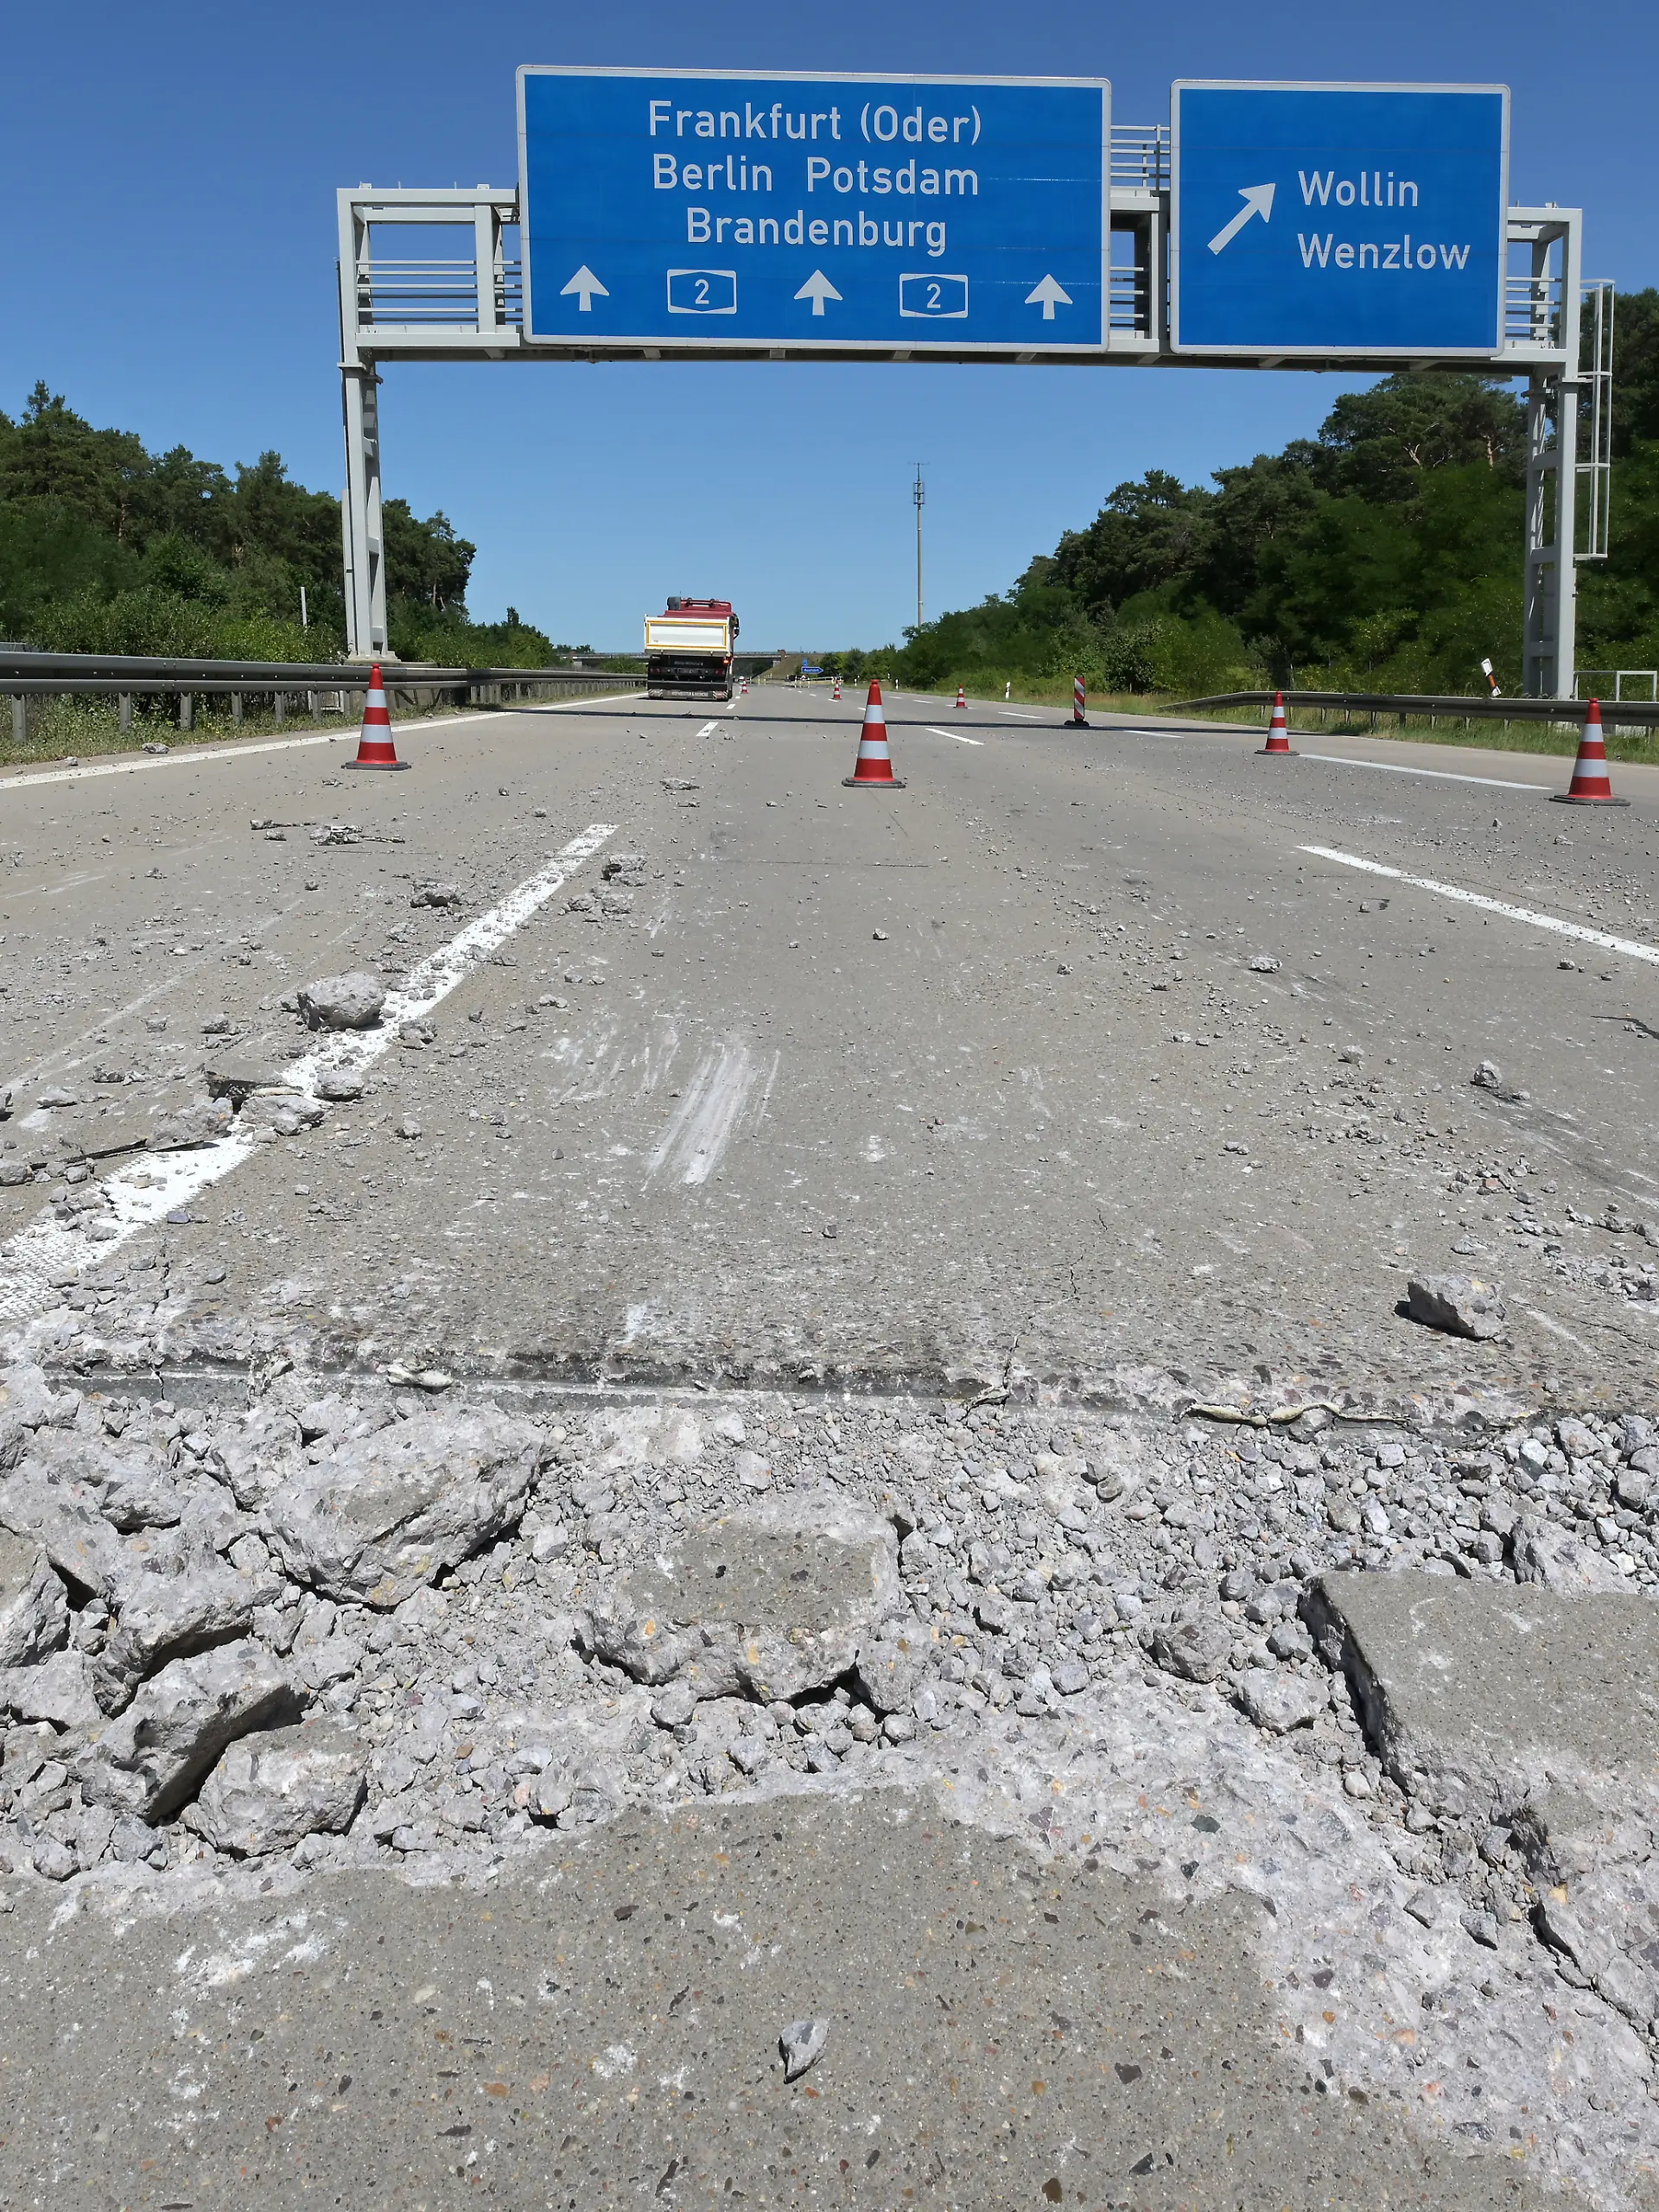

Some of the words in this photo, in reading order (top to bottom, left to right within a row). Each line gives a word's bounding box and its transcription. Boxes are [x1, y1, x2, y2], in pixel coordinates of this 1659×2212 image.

[649, 99, 841, 140] Frankfurt
[861, 102, 982, 145] (Oder)
[653, 153, 772, 191] Berlin
[807, 156, 978, 195] Potsdam
[1298, 170, 1419, 207] Wollin
[687, 207, 946, 257] Brandenburg
[1297, 233, 1471, 270] Wenzlow
[694, 279, 709, 304] 2
[926, 283, 941, 308] 2
